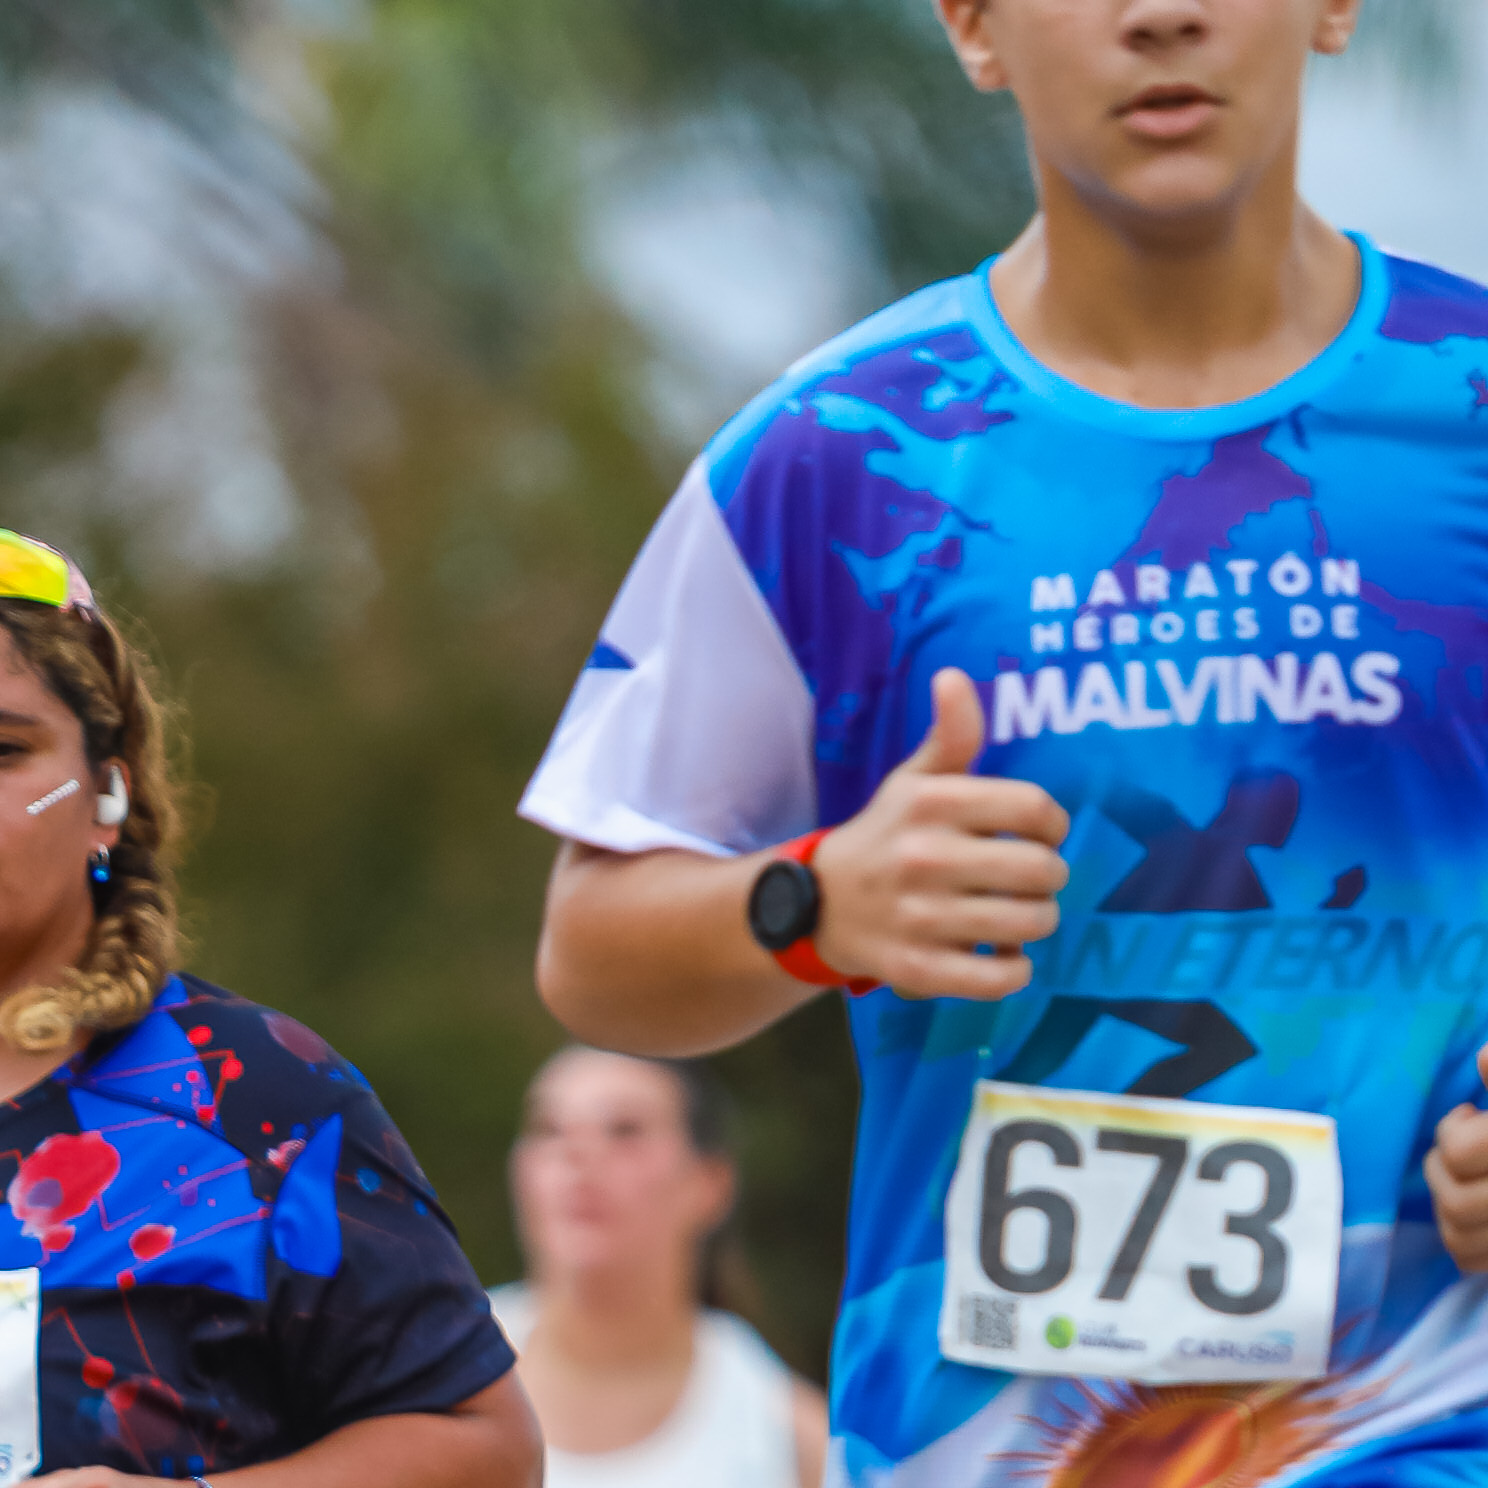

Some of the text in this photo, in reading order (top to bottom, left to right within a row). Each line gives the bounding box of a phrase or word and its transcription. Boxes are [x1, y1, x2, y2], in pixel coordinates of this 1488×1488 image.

[1030, 550, 1361, 612] MARATÓN
[1030, 604, 1360, 654] HÉROES DE
[992, 651, 1403, 743] MALVINAS
[978, 1118, 1295, 1316] 673
